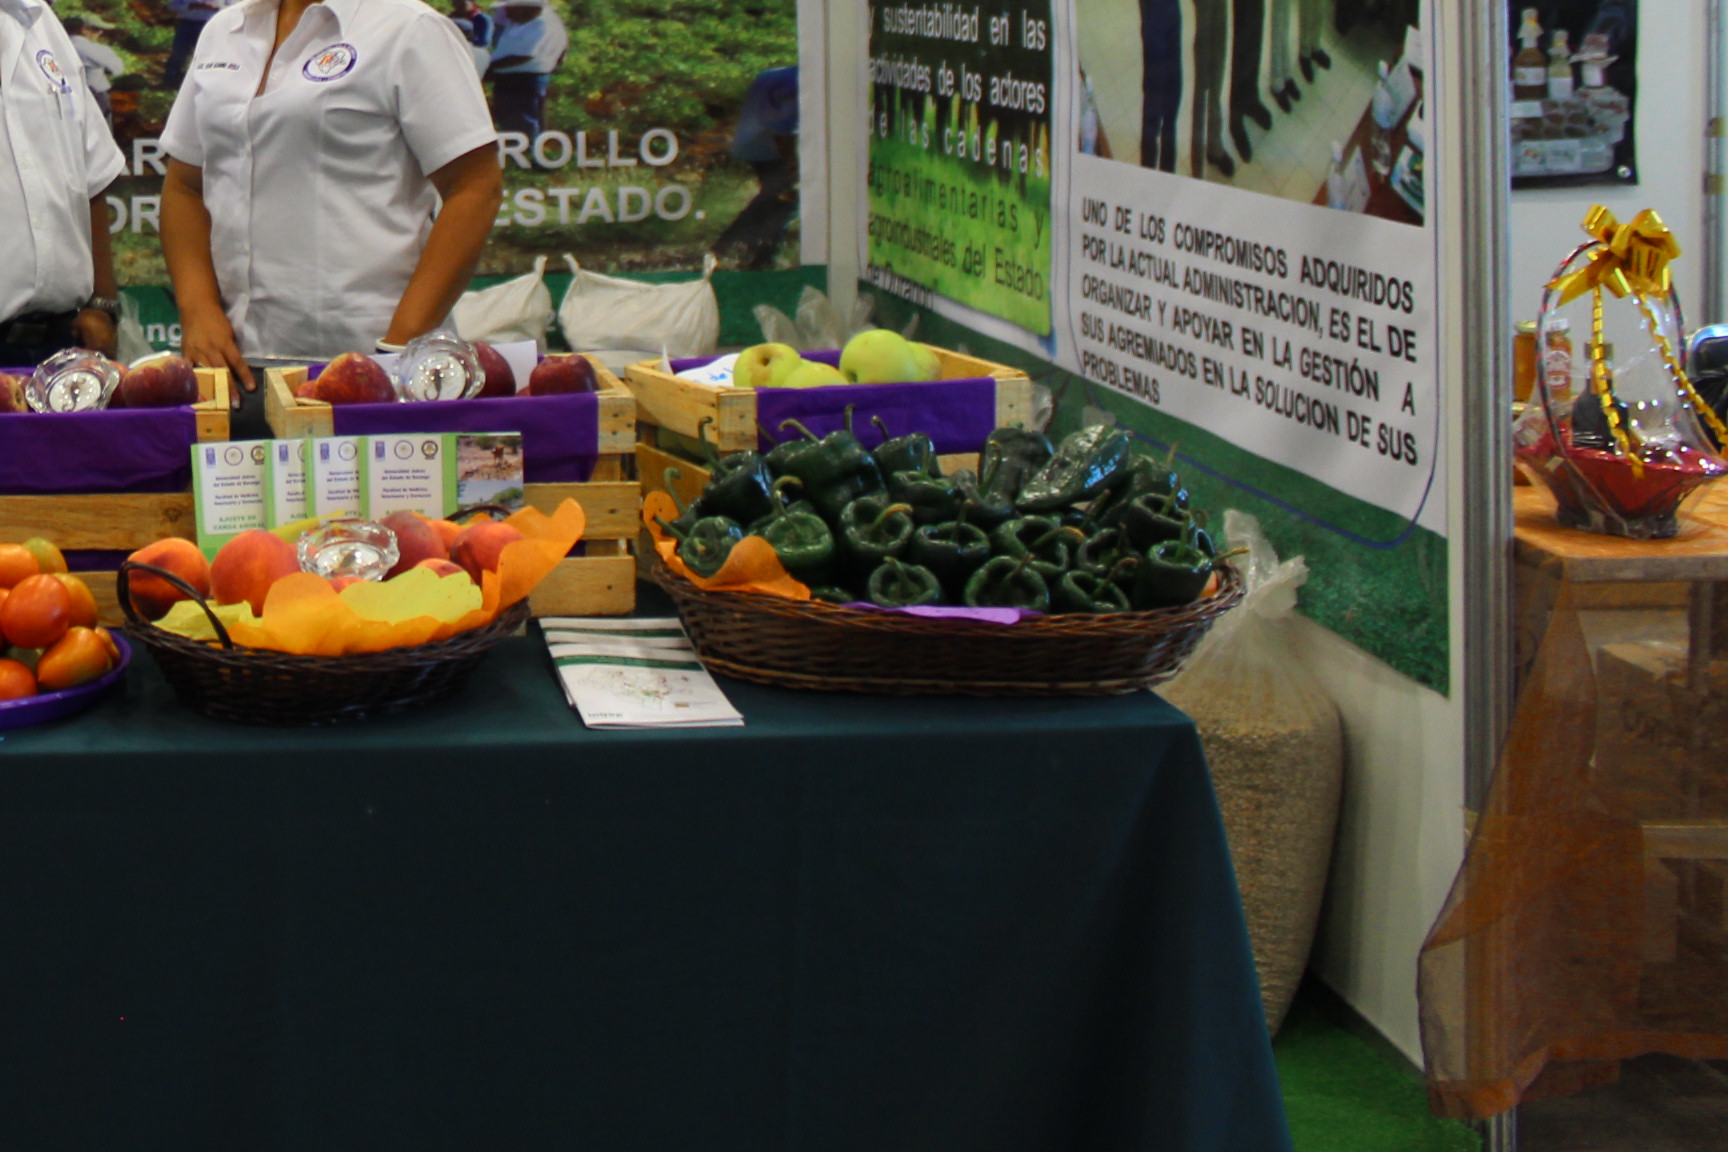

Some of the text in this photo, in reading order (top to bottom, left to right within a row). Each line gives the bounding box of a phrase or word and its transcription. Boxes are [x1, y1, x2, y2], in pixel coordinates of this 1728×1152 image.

[883, 1, 1046, 51] sustentabilidad en las
[869, 52, 1045, 115] actividades de los actores
[901, 108, 929, 149] las
[944, 125, 1044, 177] cadenas
[868, 158, 1044, 250] agroalimentarias y
[868, 211, 1043, 301] agroindustriales del Estado
[1082, 196, 1415, 314] UNO DE LOS COMPROMISOS ADQUIRIDOS
[1082, 234, 1417, 364] POR LA ACTUAL ADMINISTRACION, ES EL DE
[1081, 312, 1418, 467] SUS AGREMIADOS EN LA SOLUCION DE SUS
[1082, 273, 1416, 417] ORGANIZAR Y APOYAR EN LA GESTIÓN A
[1082, 349, 1161, 405] PROBLEMAS
